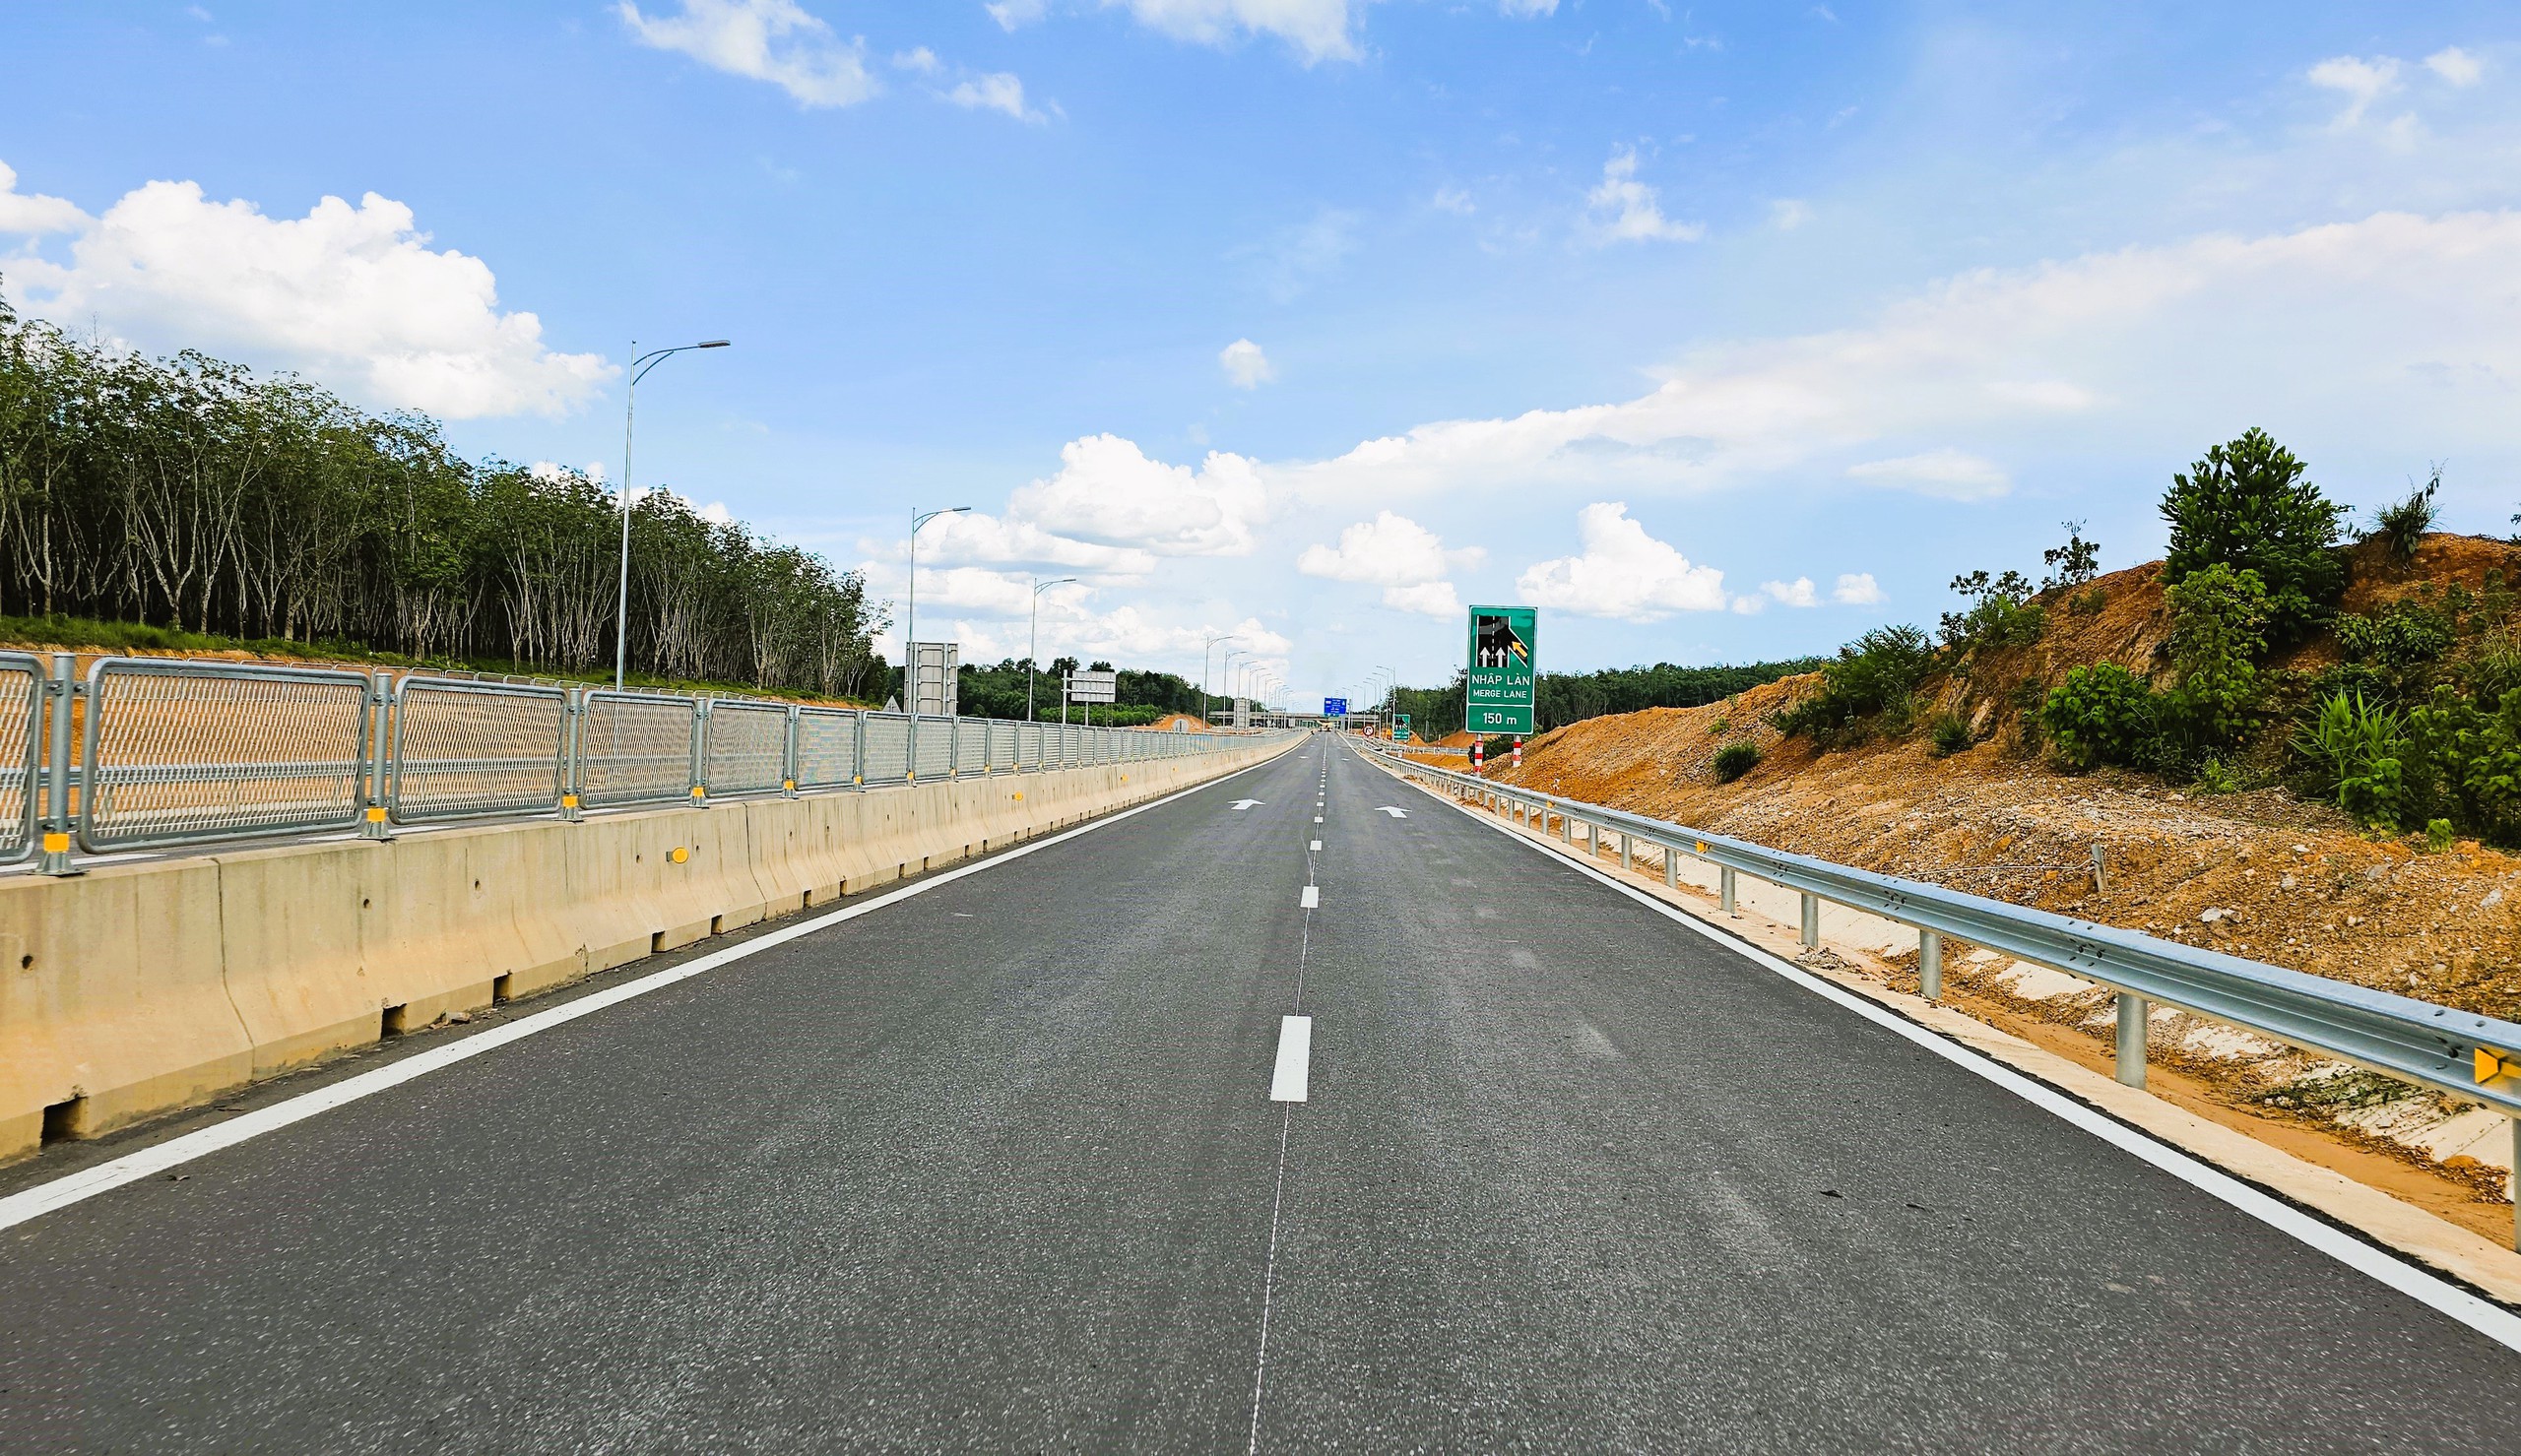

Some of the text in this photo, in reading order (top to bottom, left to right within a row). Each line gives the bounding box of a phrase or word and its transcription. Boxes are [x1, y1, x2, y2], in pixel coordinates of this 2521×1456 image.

[1507, 672, 1530, 686] LÀN
[1472, 689, 1527, 699] MERGE LANE
[1483, 712, 1518, 725] 150 m
